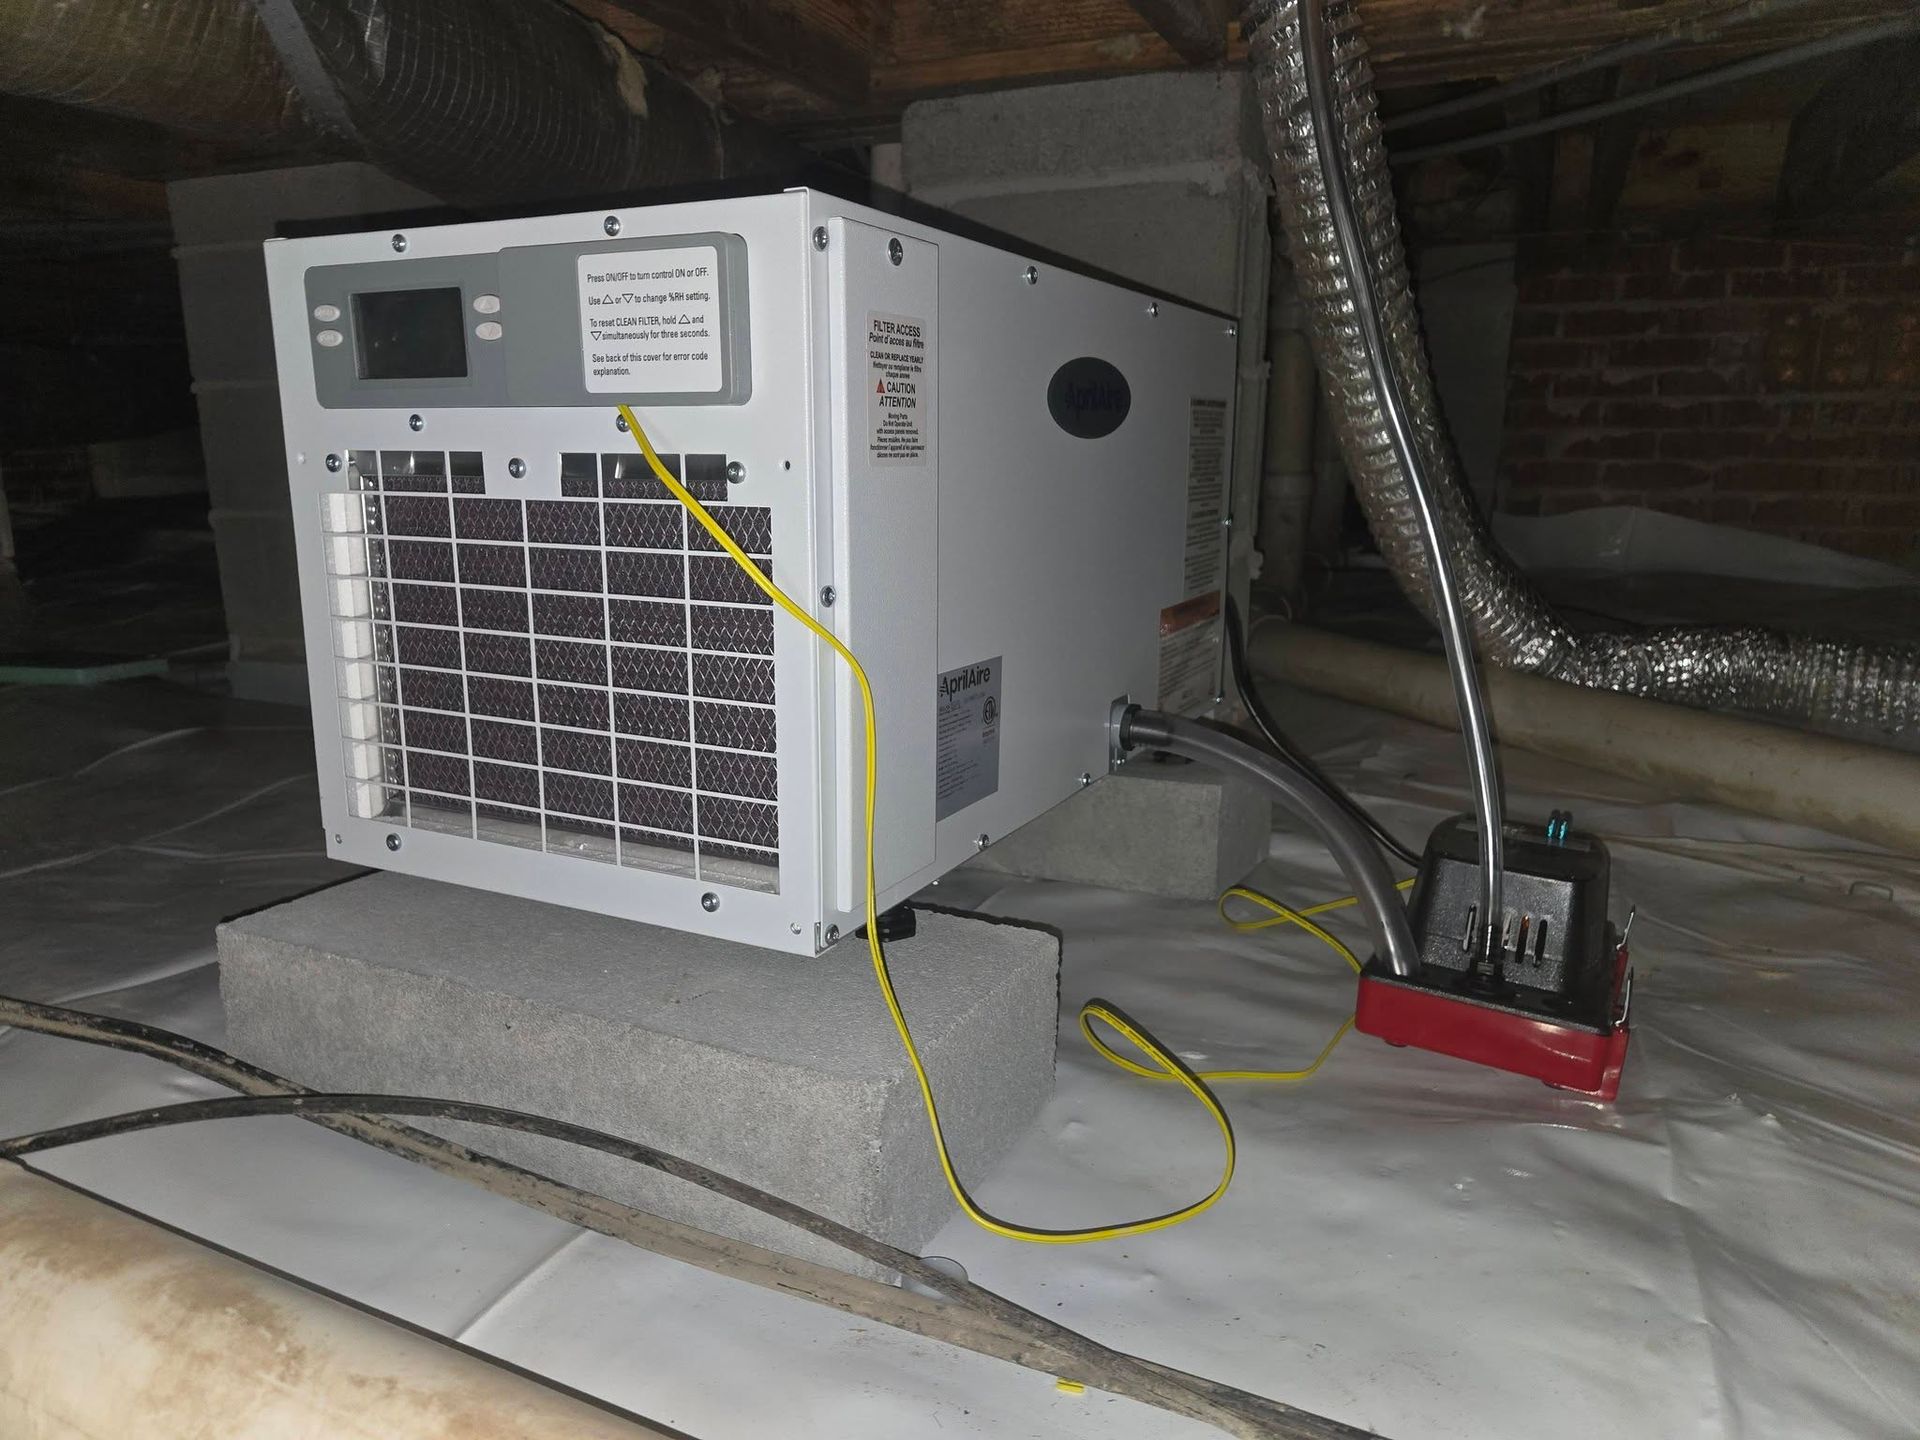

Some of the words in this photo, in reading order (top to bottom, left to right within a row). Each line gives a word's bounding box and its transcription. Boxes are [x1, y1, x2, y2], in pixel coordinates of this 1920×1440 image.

[587, 274, 604, 282] Press
[606, 272, 628, 282] ON/OFF
[652, 269, 674, 279] control
[675, 269, 685, 278] ON
[695, 267, 709, 276] OFF.
[588, 296, 600, 305] Use
[634, 295, 641, 303] to
[643, 294, 667, 304] change
[668, 292, 684, 301] %RH
[686, 291, 710, 302] setting.
[590, 318, 597, 328] To
[598, 319, 615, 327] reset
[616, 317, 637, 326] CLEAN
[638, 316, 660, 326] FILTER,
[662, 316, 676, 324] hold
[692, 315, 704, 324] and
[602, 330, 650, 340] simultaneously
[650, 330, 660, 338] for
[661, 330, 678, 338] three
[680, 328, 710, 338] seconds.
[874, 320, 895, 334] FILTER
[896, 323, 920, 337] ACCESS
[869, 332, 884, 343] Point
[913, 339, 924, 349] filtre
[592, 353, 604, 363] See
[606, 353, 621, 362] back
[622, 353, 629, 362] of
[630, 352, 642, 361] this
[643, 353, 661, 361] cover
[662, 352, 672, 360] for
[673, 352, 690, 360] error
[692, 351, 708, 360] code
[870, 351, 883, 359] CLEAN
[891, 353, 909, 362] REPLACE
[593, 367, 630, 378] explanation.
[887, 381, 916, 394] CAUTION
[879, 396, 916, 408] ATTENTION
[939, 666, 991, 702] AprilAire
